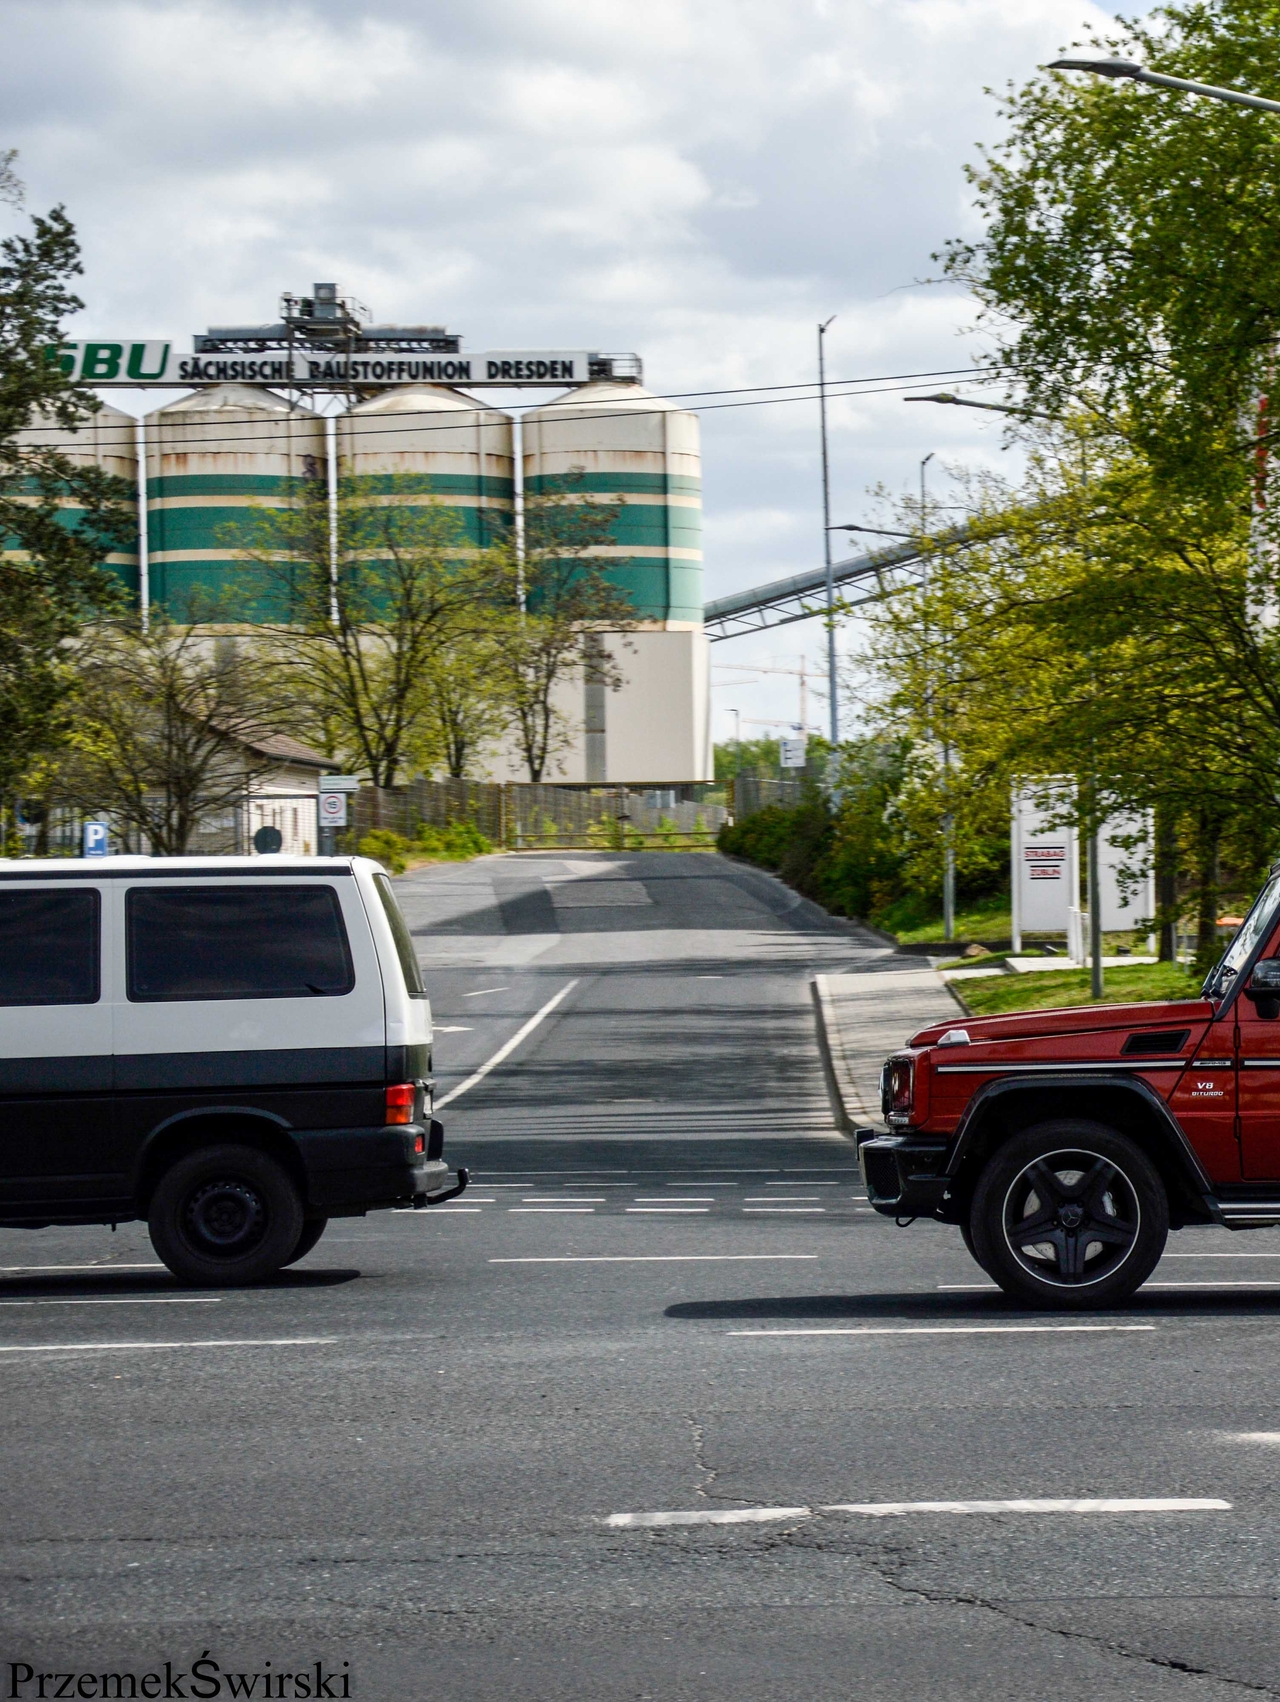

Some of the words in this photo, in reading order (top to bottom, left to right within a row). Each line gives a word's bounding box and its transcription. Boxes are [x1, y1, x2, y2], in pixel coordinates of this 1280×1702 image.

[308, 360, 471, 380] BAUSTOFFUNION
[487, 360, 574, 379] DRESDEN
[87, 825, 104, 848] P
[1197, 1082, 1214, 1090] V8
